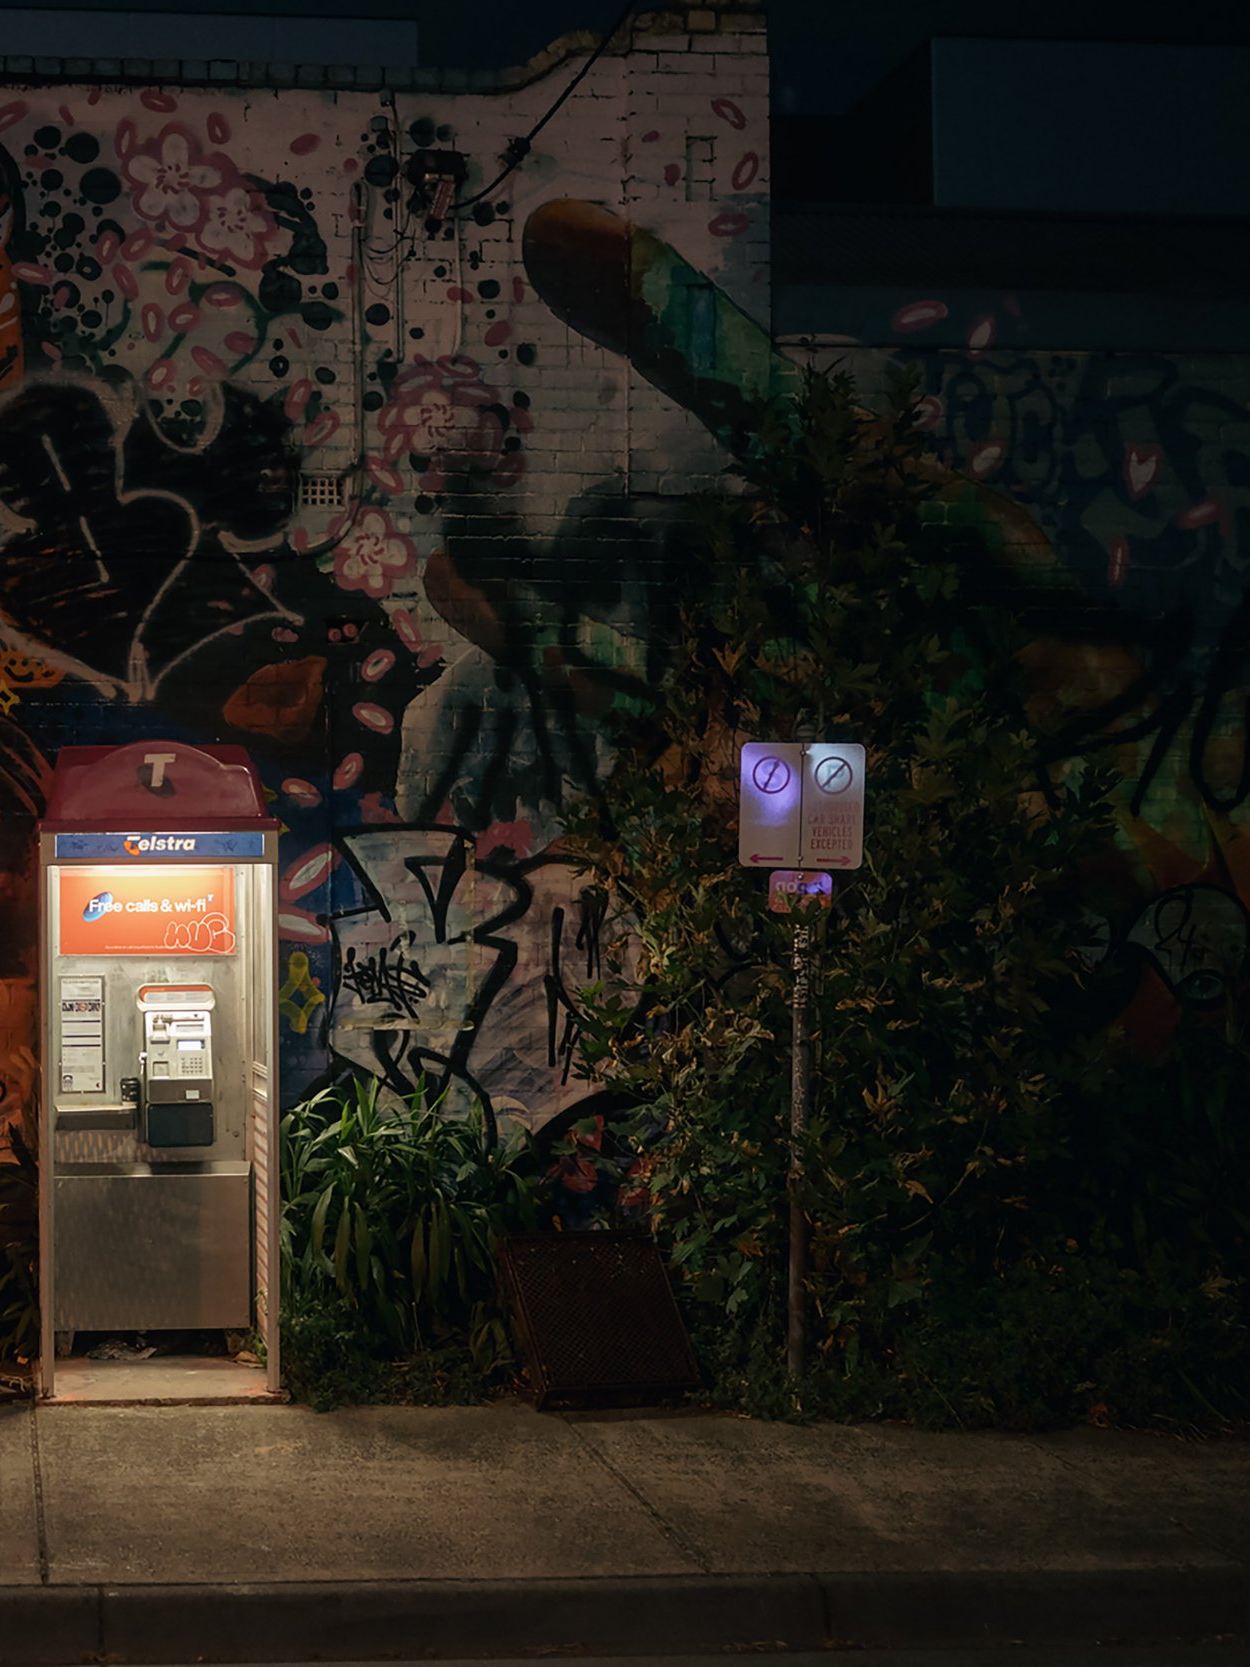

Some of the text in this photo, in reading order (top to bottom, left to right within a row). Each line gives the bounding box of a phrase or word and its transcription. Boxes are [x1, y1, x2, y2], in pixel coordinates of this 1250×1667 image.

[143, 753, 176, 788] T
[812, 826, 853, 838] VEHICLES
[124, 836, 196, 856] Telstra
[810, 838, 854, 850] EXCEPTED
[88, 899, 122, 913] Free
[125, 898, 158, 913] calls
[160, 899, 173, 913] &
[174, 898, 206, 912] wi-fi
